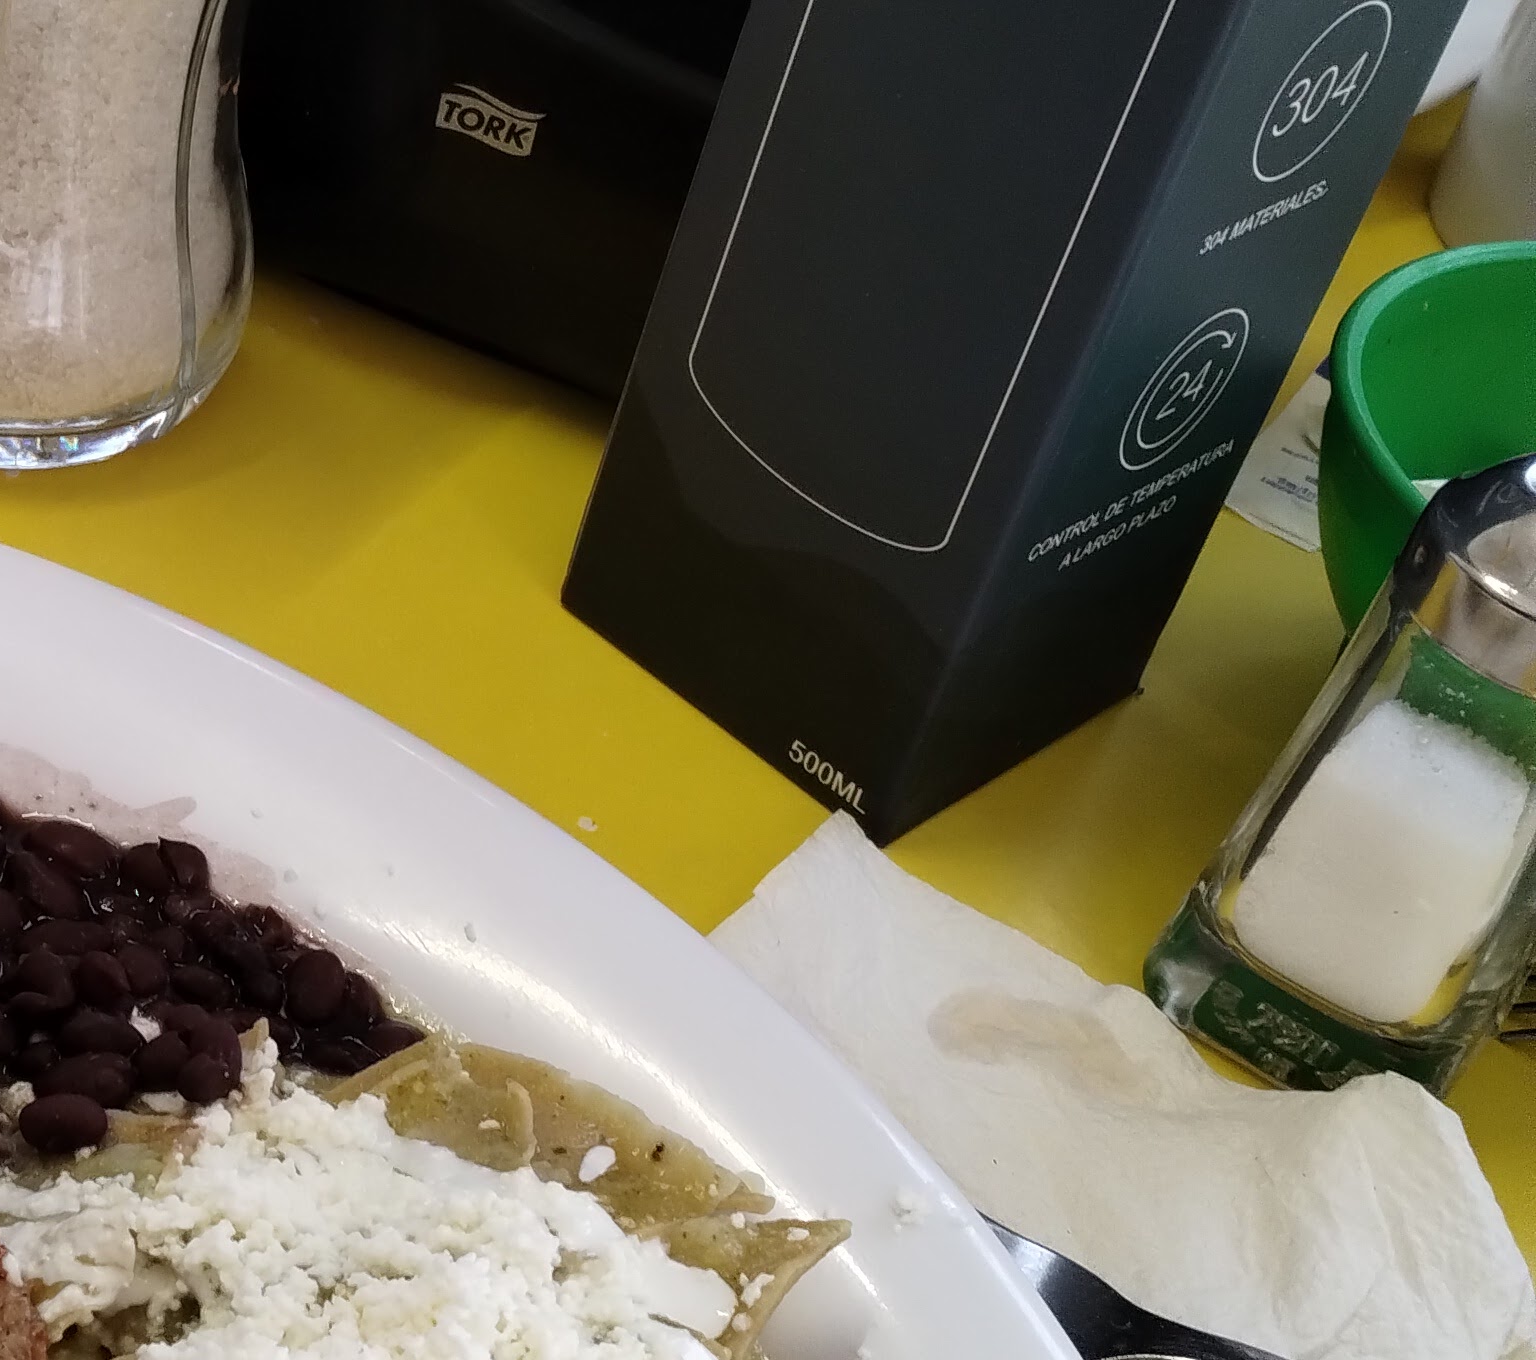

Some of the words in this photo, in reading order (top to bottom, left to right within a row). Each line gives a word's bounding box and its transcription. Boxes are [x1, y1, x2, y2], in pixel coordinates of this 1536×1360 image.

[443, 98, 532, 150] TORK
[1272, 50, 1369, 137] 304
[1228, 180, 1329, 240] MATERIALES
[1155, 358, 1213, 421] 24
[1027, 510, 1101, 562] CONTROL
[1103, 497, 1129, 522] DE
[1130, 438, 1235, 508] TEMPERATURA
[1072, 522, 1127, 563] LARGO
[1127, 495, 1178, 533] PLAZO
[788, 739, 866, 815] 500ML
